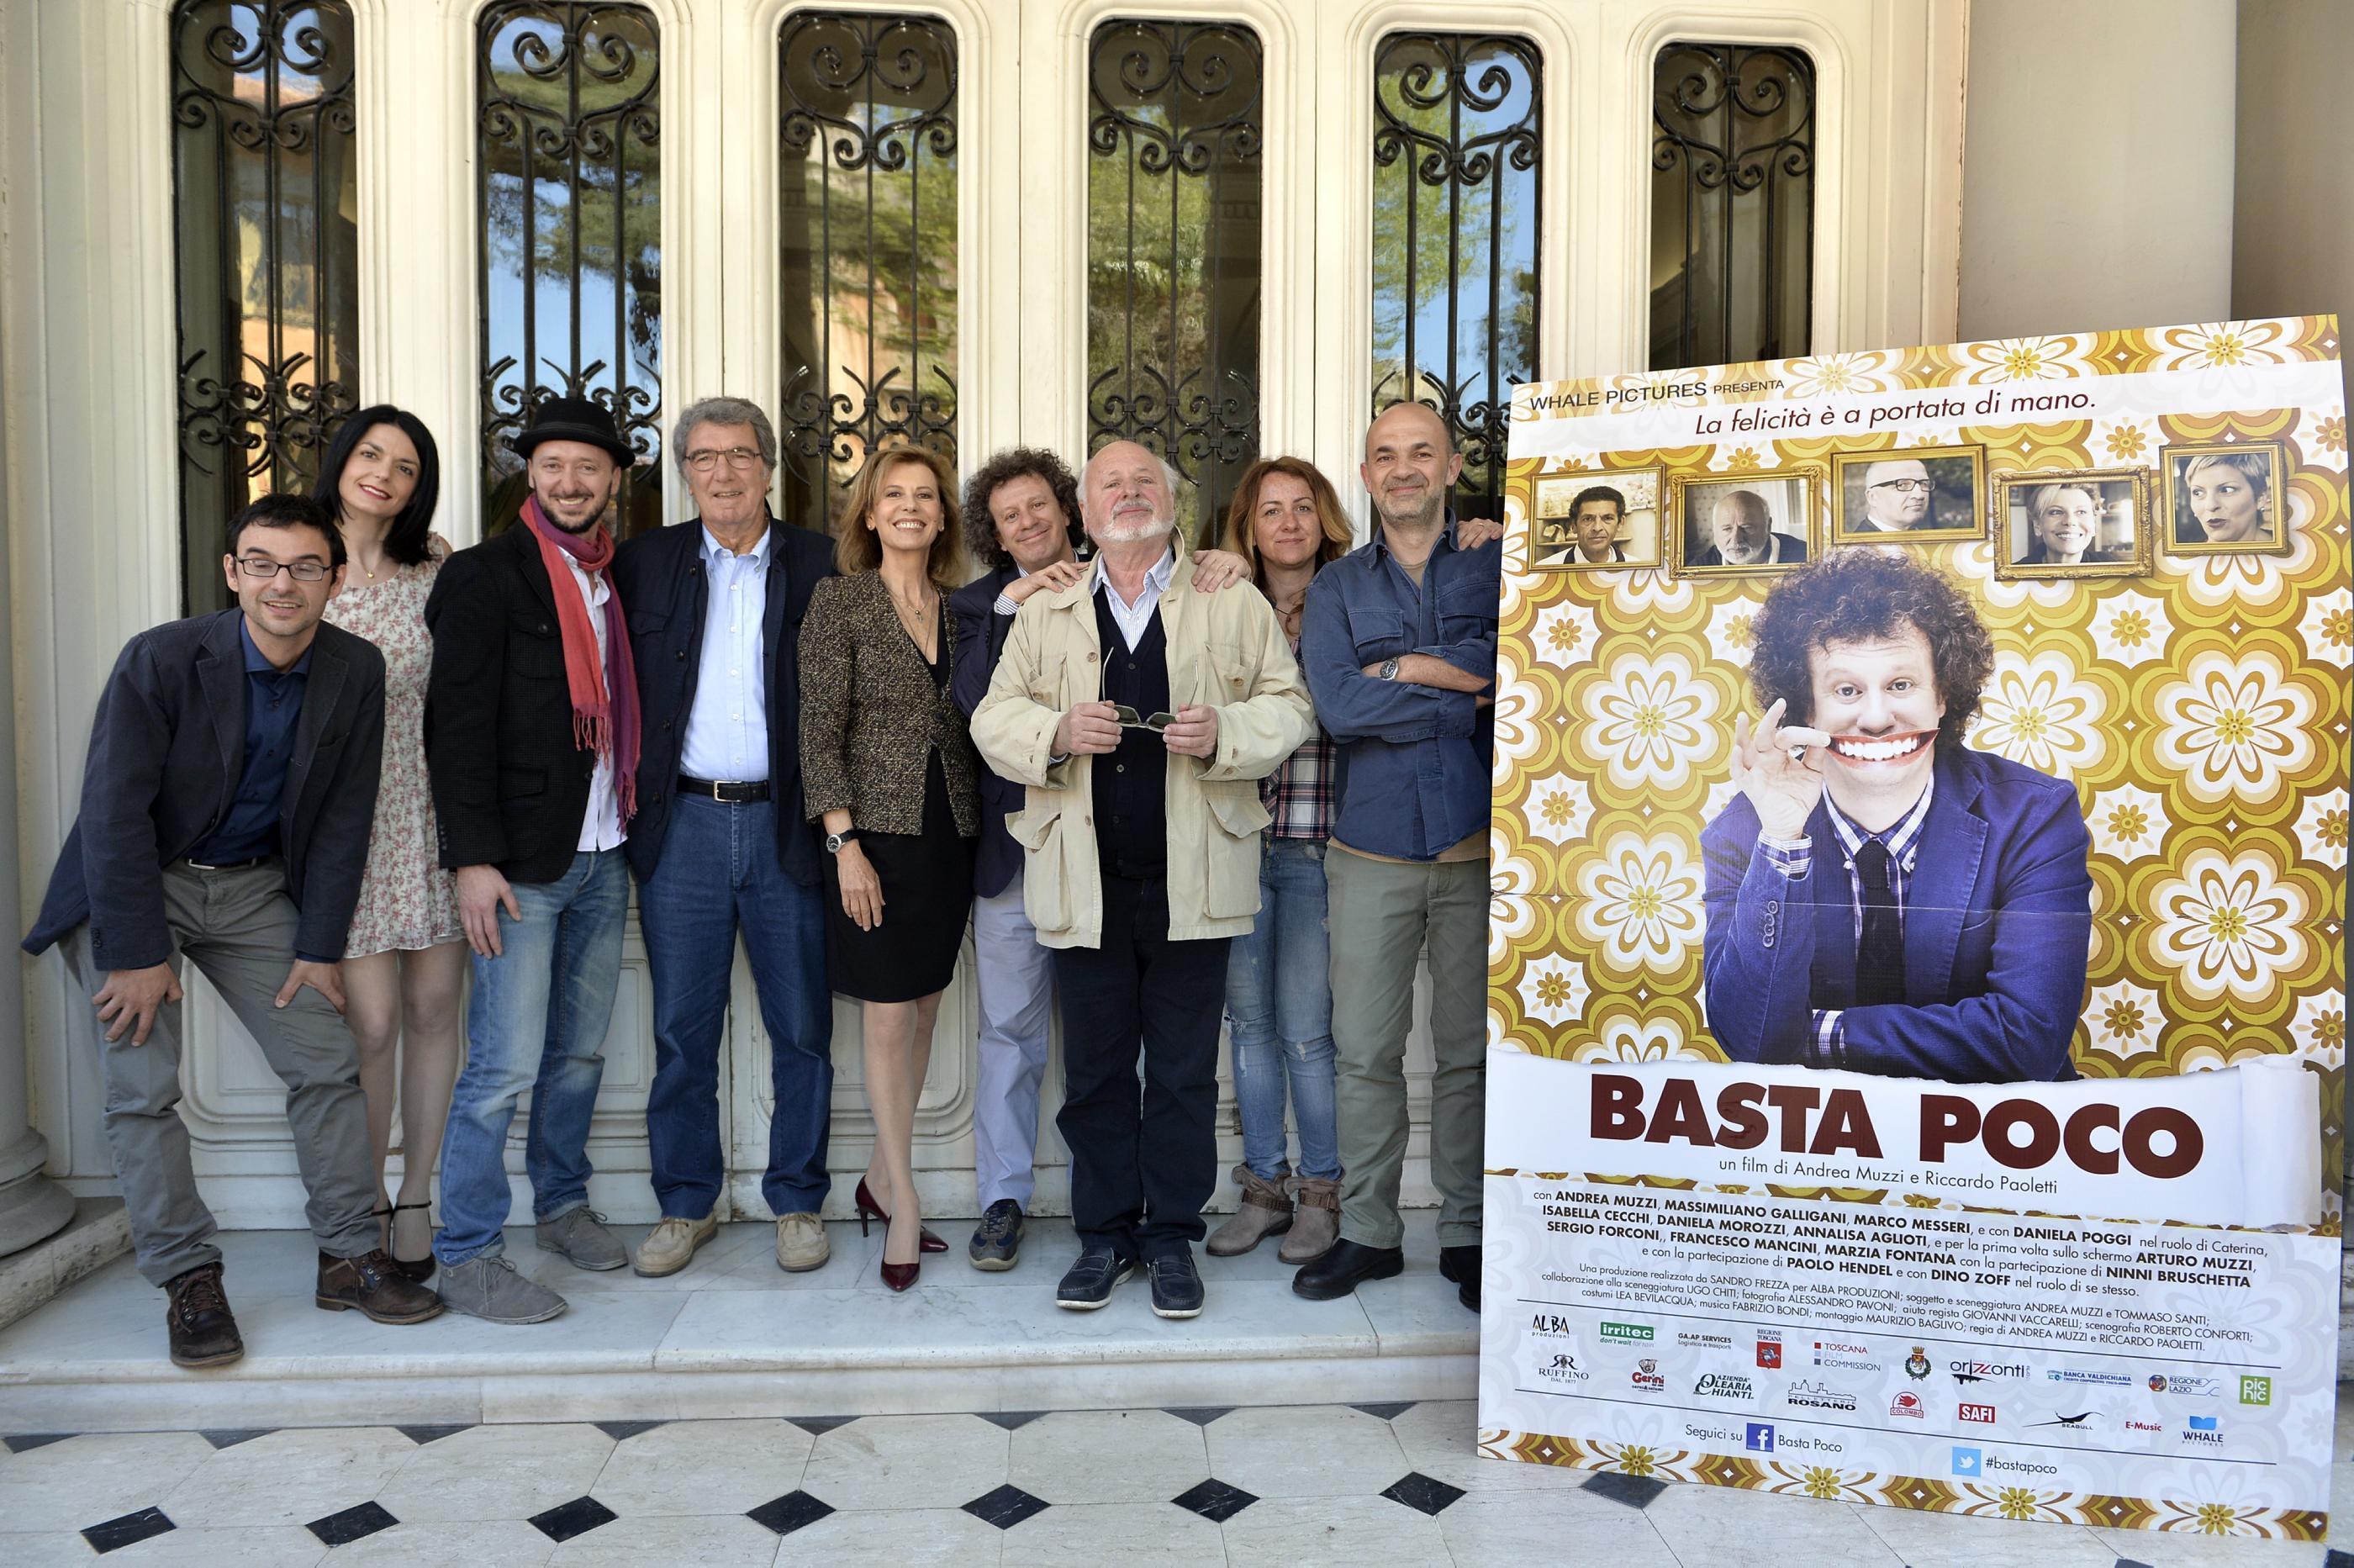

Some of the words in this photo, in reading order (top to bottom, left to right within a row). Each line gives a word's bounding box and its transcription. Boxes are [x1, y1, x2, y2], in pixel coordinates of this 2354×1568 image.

[1529, 391, 1600, 411] WHALE
[1606, 381, 1707, 404] PICTURES
[1713, 379, 1785, 394] PRESENTA
[1695, 414, 1723, 435] La
[1731, 406, 1812, 432] felicità
[1820, 404, 1835, 425] è
[1844, 409, 1861, 424] a
[1868, 398, 1966, 430] portata
[1975, 388, 2002, 414] di
[2010, 393, 2096, 412] mano.
[1590, 1073, 1883, 1159] BASTA
[1919, 1093, 2204, 1178] POCO
[1718, 1159, 1736, 1171] un
[1741, 1155, 1768, 1174] film
[1773, 1158, 1788, 1175] di
[1792, 1160, 1850, 1180] Andrea
[1855, 1164, 1904, 1183] Muzzi
[1909, 1173, 1919, 1185] e
[1924, 1169, 1995, 1190] Riccardo
[1999, 1175, 2057, 1195] Paoletti
[1533, 1191, 1552, 1200] con
[1554, 1190, 1610, 1205] ANDREA
[1664, 1198, 1767, 1217] MASSIMILIANO
[1853, 1213, 1908, 1228] MARCO
[1977, 1226, 1986, 1234] e
[1987, 1227, 2010, 1237] con
[2013, 1225, 2077, 1242] DANIELA
[2081, 1230, 2132, 1245] POGGI
[2139, 1234, 2157, 1248] nel
[2161, 1236, 2193, 1250] ruolo
[2195, 1237, 2209, 1251] di
[1542, 1204, 1601, 1219] ISABELLA
[1656, 1213, 1716, 1229] DANIELA
[1792, 1224, 1867, 1242] ANNALISA
[1934, 1239, 1942, 1248] e
[1945, 1240, 1965, 1251] per
[1967, 1236, 1979, 1250] la
[1982, 1240, 2017, 1254] prima
[2019, 1242, 2049, 1256] volta
[2051, 1243, 2079, 1258] sullo
[2082, 1246, 2133, 1262] schermo
[2135, 1251, 2198, 1267] ARTURO
[1546, 1220, 1595, 1234] SERGIO
[1670, 1230, 1750, 1248] FRANCESCO
[1824, 1243, 1882, 1259] MARZIA
[1885, 1248, 1956, 1265] FONTANA
[1959, 1258, 1981, 1267] con
[1983, 1254, 1995, 1268] la
[1998, 1259, 2087, 1275] partecipazione
[2089, 1263, 2103, 1276] di
[2105, 1265, 2153, 1280] NINNI
[2156, 1270, 2251, 1287] BRUSCHETTA
[1641, 1247, 1649, 1255] e
[1650, 1248, 1671, 1257] con
[1674, 1244, 1685, 1258] la
[1686, 1250, 1770, 1265] partecipazione
[1771, 1254, 1783, 1267] di
[1787, 1256, 1835, 1270] PAOLO
[1839, 1260, 1893, 1276] HENDEL
[1895, 1269, 1904, 1277] e
[1906, 1270, 1928, 1279] con
[1930, 1268, 1970, 1282] DINO
[1973, 1270, 2012, 1286] ZOFF
[2014, 1275, 2032, 1288] nel
[2035, 1274, 2067, 1291] ruolo
[2069, 1278, 2082, 1291] di
[2084, 1284, 2098, 1293] se
[1578, 1263, 1597, 1273] Una
[1598, 1265, 1649, 1280] produzione
[1649, 1270, 1694, 1281] realizzata
[1695, 1273, 1707, 1283] da
[1709, 1275, 1753, 1286] SANDRO
[1754, 1279, 1791, 1290] FREZZA
[1792, 1285, 1808, 1296] per
[1809, 1284, 1835, 1294] ALBA
[1905, 1295, 1945, 1305] soggetto
[1955, 1299, 2021, 1311] sceneggiatura
[2023, 1302, 2069, 1314] ANDREA
[2069, 1306, 2103, 1317] MUZZI
[2113, 1309, 2173, 1323] TOMMASO
[1541, 1272, 1604, 1286] collaborazione
[1605, 1277, 1623, 1287] alla
[1623, 1281, 1685, 1293] sceneggiatura
[1686, 1285, 1711, 1295] UGO
[1741, 1289, 1786, 1302] fotografia
[1787, 1293, 1854, 1308] ALESSANDRO
[1902, 1303, 1926, 1314] aiuto
[1928, 1307, 1960, 1318] regista
[1961, 1309, 2017, 1323] GIOVANNI
[2084, 1322, 2141, 1333] scenografia
[2143, 1324, 2193, 1337] ROBERTO
[1533, 1314, 1570, 1334] ALBA
[1581, 1290, 1613, 1298] costumi
[1615, 1291, 1633, 1300] LEA
[1699, 1300, 1730, 1309] musica
[1731, 1301, 1776, 1313] FABRIZIO
[1814, 1312, 1864, 1323] montaggio
[1865, 1313, 1916, 1326] MAURIZIO
[1968, 1324, 1994, 1335] regia
[1996, 1324, 2006, 1334] di
[2008, 1326, 2054, 1338] ANDREA
[2054, 1330, 2087, 1341] MUZZI
[2098, 1333, 2155, 1346] RICCARDO
[1602, 1323, 1653, 1338] irritec
[1702, 1334, 1732, 1344] SERVICES
[1824, 1343, 1868, 1354] TOSCANA
[1539, 1367, 1590, 1381] RUFFINO
[1824, 1359, 1881, 1372] COMMISSION
[1632, 1371, 1665, 1385] Gerini
[1717, 1375, 1748, 1383] AZIENDA
[2063, 1370, 2086, 1379] BANCA
[2087, 1373, 2132, 1382] VALDICHIANA
[2169, 1376, 2203, 1386] REGIONE
[2169, 1385, 2193, 1393] LAZIO
[1787, 1398, 1856, 1411] ROSANO
[1892, 1408, 1923, 1417] COLOMBO
[1961, 1405, 1993, 1422] SAFI
[1686, 1423, 1727, 1441] Seguici
[1730, 1431, 1743, 1441] su
[2125, 1421, 2162, 1432] E-Music
[1778, 1434, 1810, 1450] Basta
[1813, 1439, 1843, 1454] Poco
[2182, 1431, 2224, 1443] WHALE
[1985, 1456, 2058, 1476] #bastapoco
